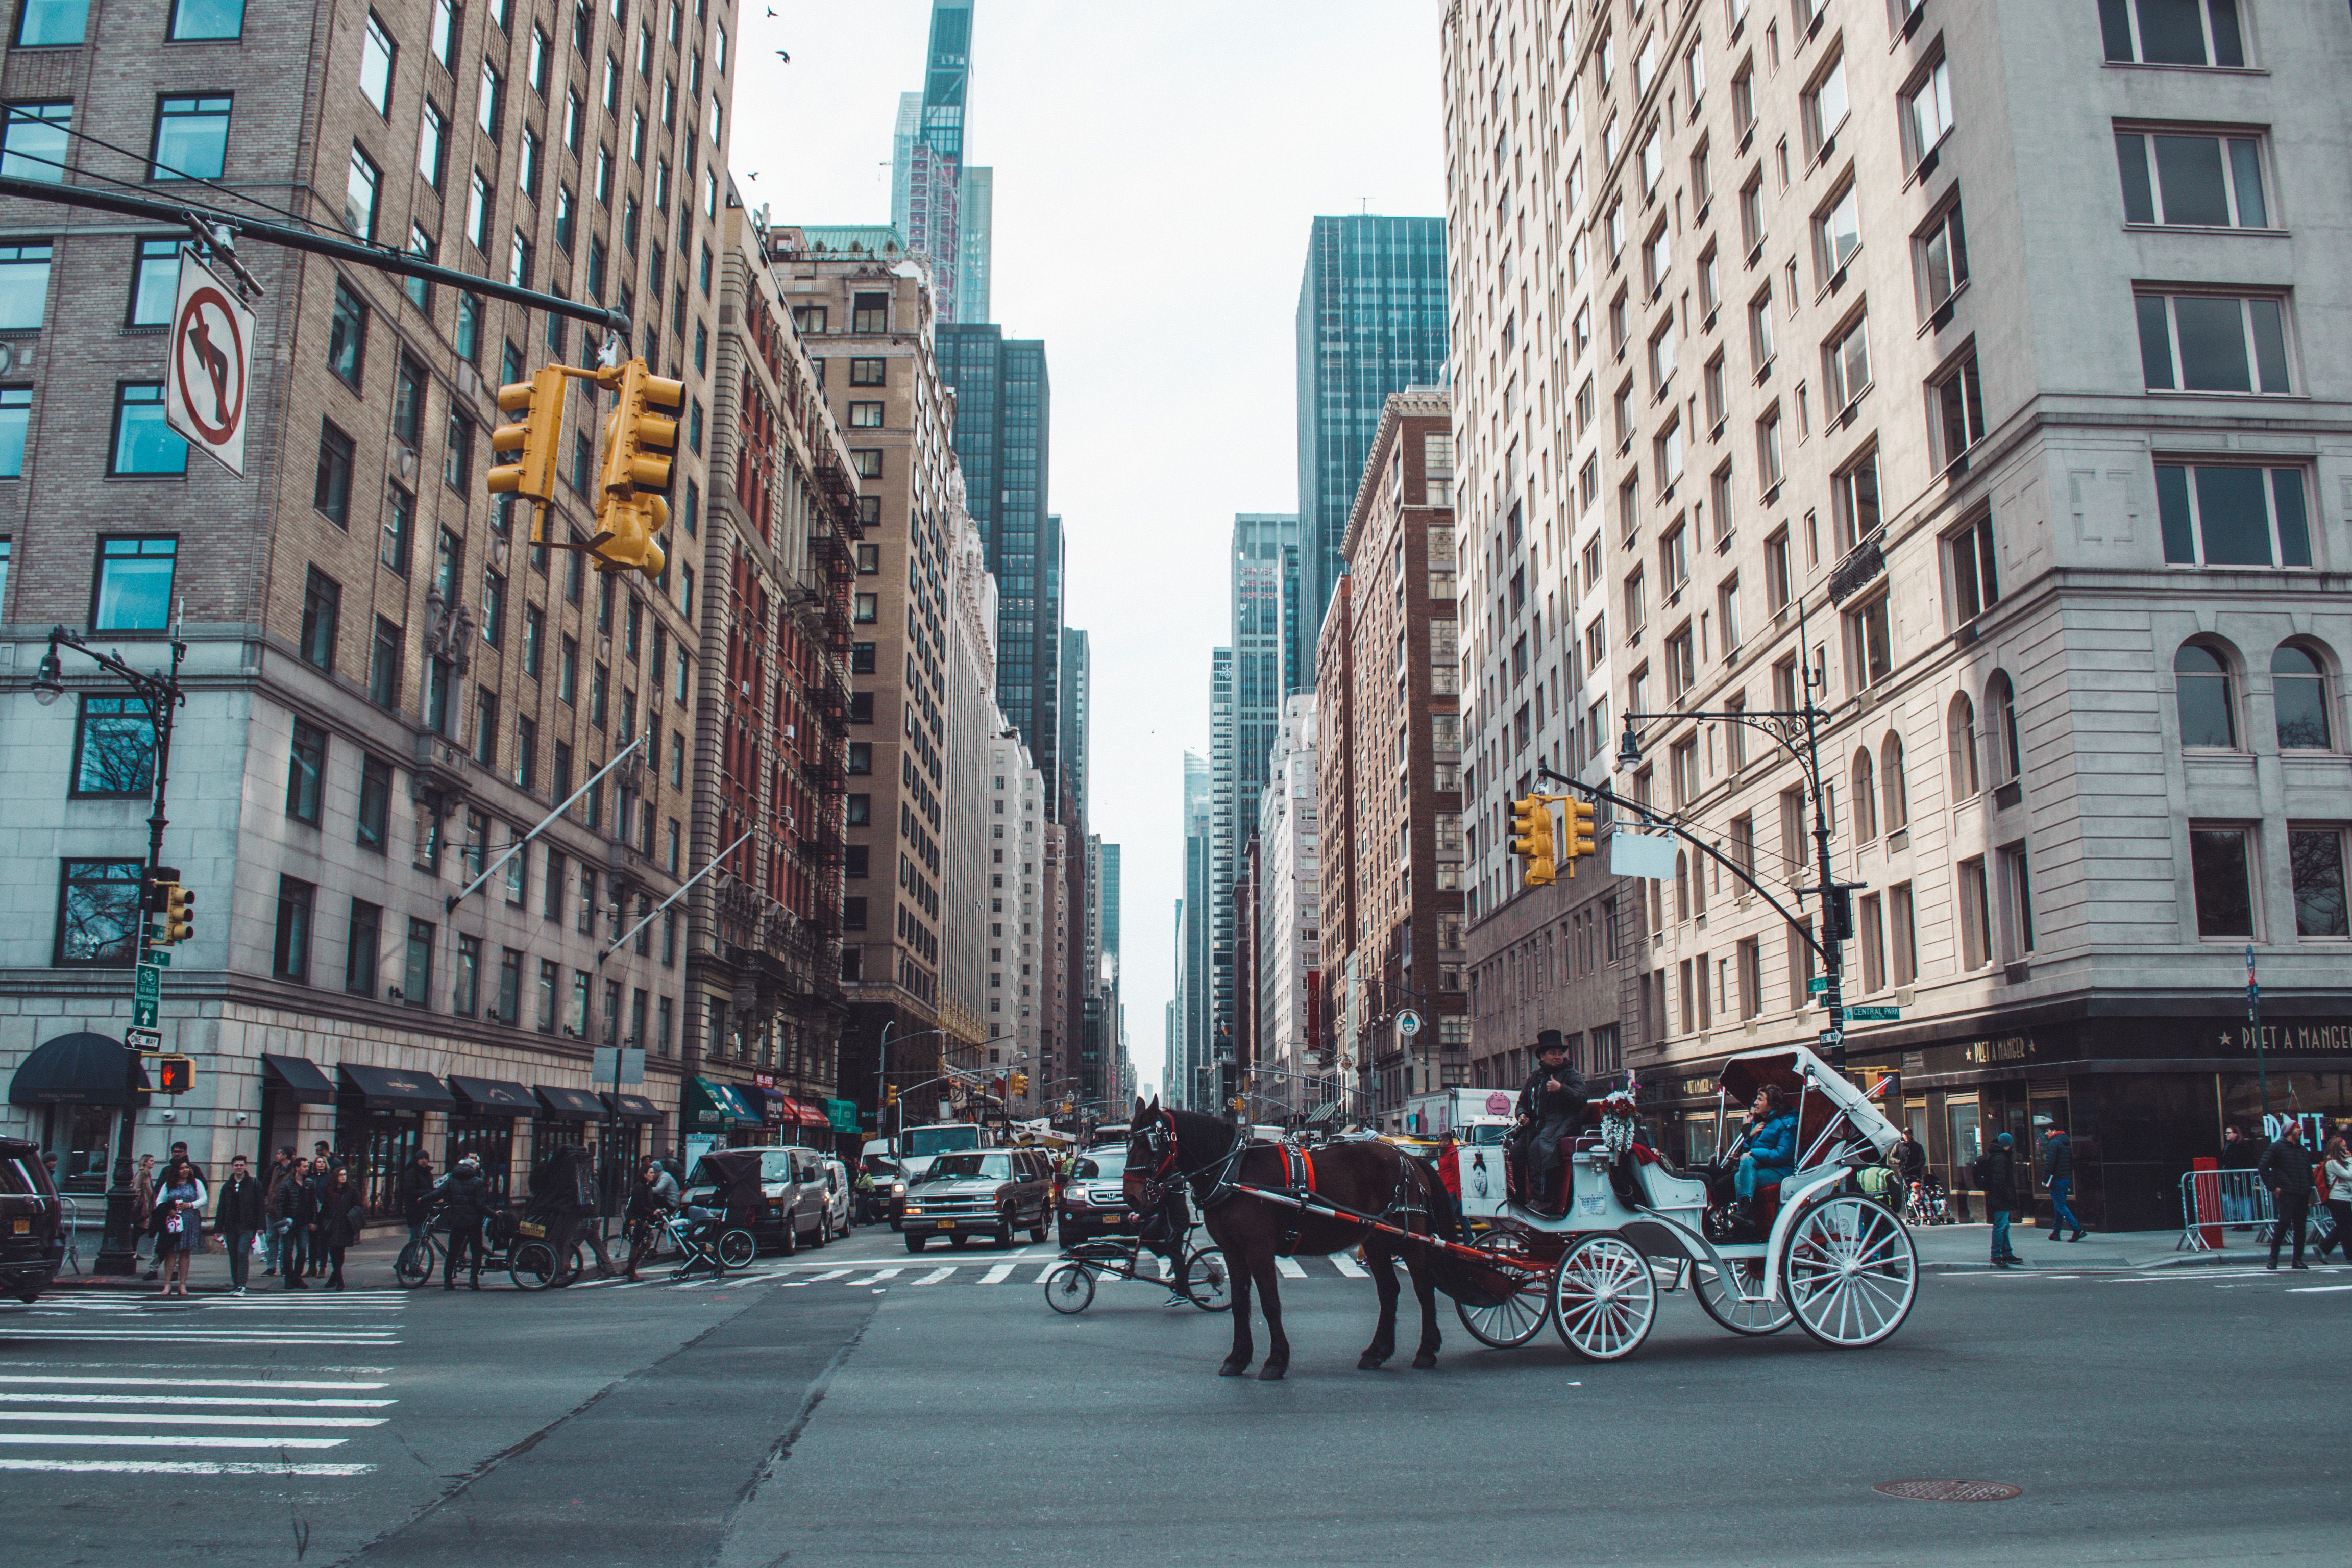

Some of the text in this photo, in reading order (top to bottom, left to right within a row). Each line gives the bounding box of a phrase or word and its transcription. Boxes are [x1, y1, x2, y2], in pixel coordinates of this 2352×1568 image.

[154, 952, 158, 963] 6
[1853, 1007, 1882, 1015] CENTRAL
[131, 1034, 157, 1046] ONE WAY
[2284, 1027, 2292, 1049] A
[2298, 1026, 2352, 1048] MANGE
[1974, 1037, 2025, 1063] PRET A MANGER
[2267, 1113, 2323, 1152] PET
